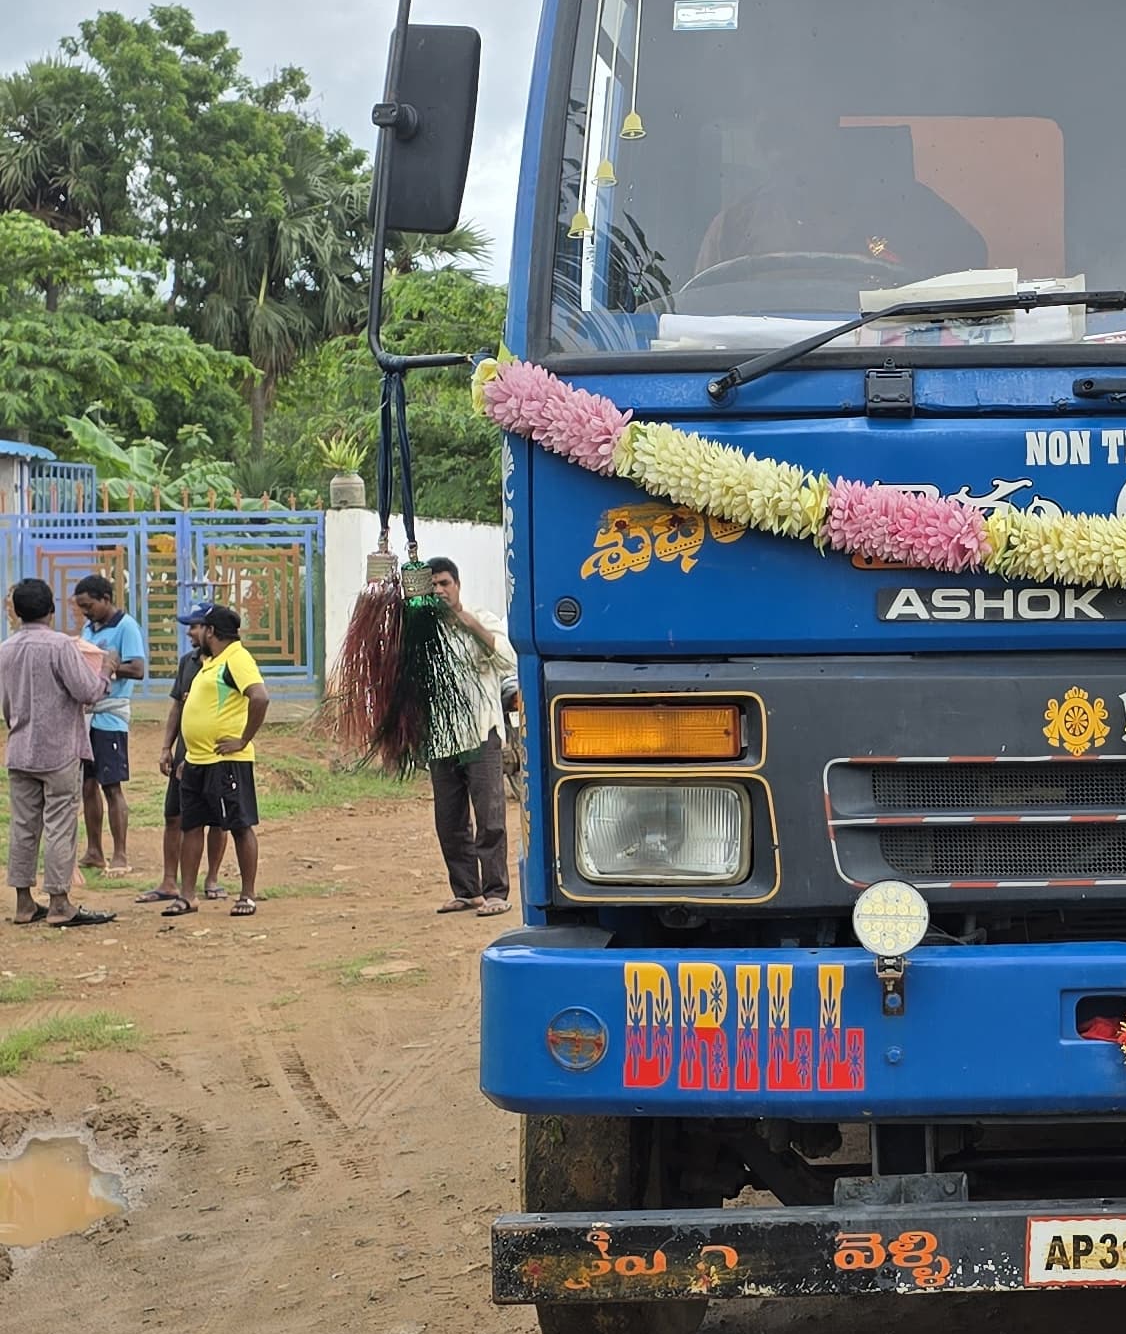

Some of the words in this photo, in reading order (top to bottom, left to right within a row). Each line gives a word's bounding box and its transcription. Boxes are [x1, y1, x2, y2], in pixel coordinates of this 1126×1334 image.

[1025, 431, 1091, 466] NON
[884, 587, 1106, 620] ASHOK
[622, 961, 866, 1093] DRILL
